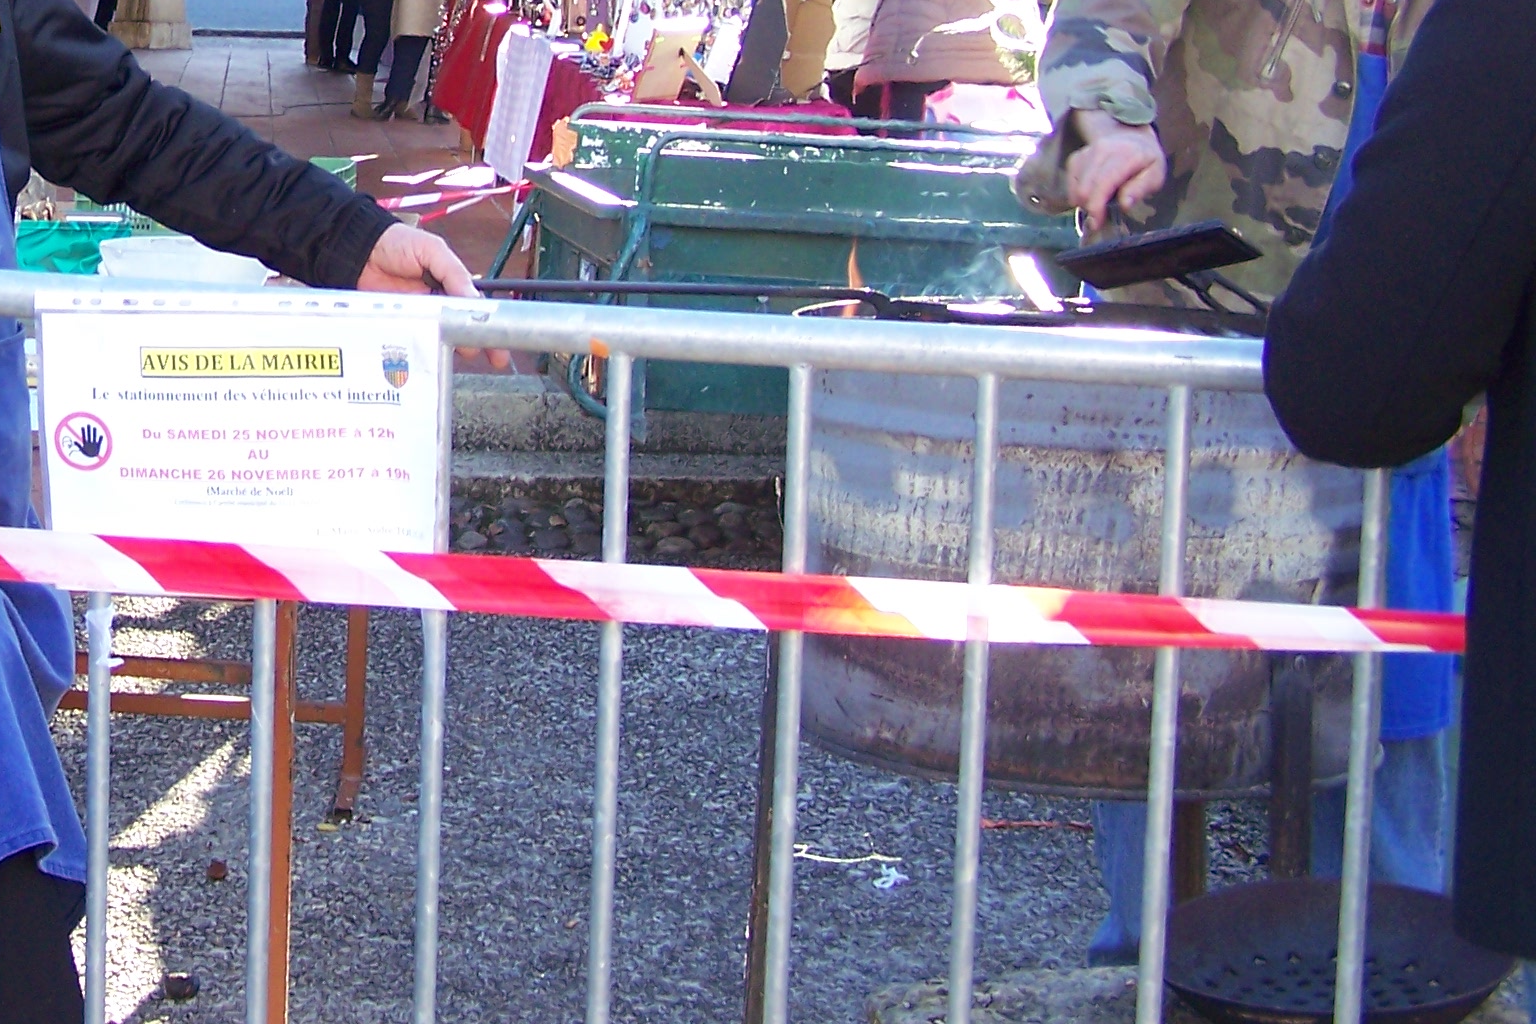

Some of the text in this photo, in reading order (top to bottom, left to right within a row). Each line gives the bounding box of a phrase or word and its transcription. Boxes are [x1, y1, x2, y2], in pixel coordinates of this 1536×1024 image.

[141, 352, 340, 371] AVIS DE LA MAIRIE
[92, 387, 402, 403] Le stationnement des véhicules est interdit
[142, 429, 162, 439] Du
[167, 429, 227, 441] SAMEDI
[232, 429, 251, 441] 25
[256, 427, 348, 441] NOVEMBRE
[368, 427, 395, 439] 12h
[247, 448, 269, 460] AU
[119, 466, 202, 480] DIMANCHE
[207, 469, 226, 480] 26
[231, 469, 322, 481] NOVEMBRE
[327, 467, 365, 480] 2017
[386, 467, 410, 481] 19h
[250, 486, 262, 497] de
